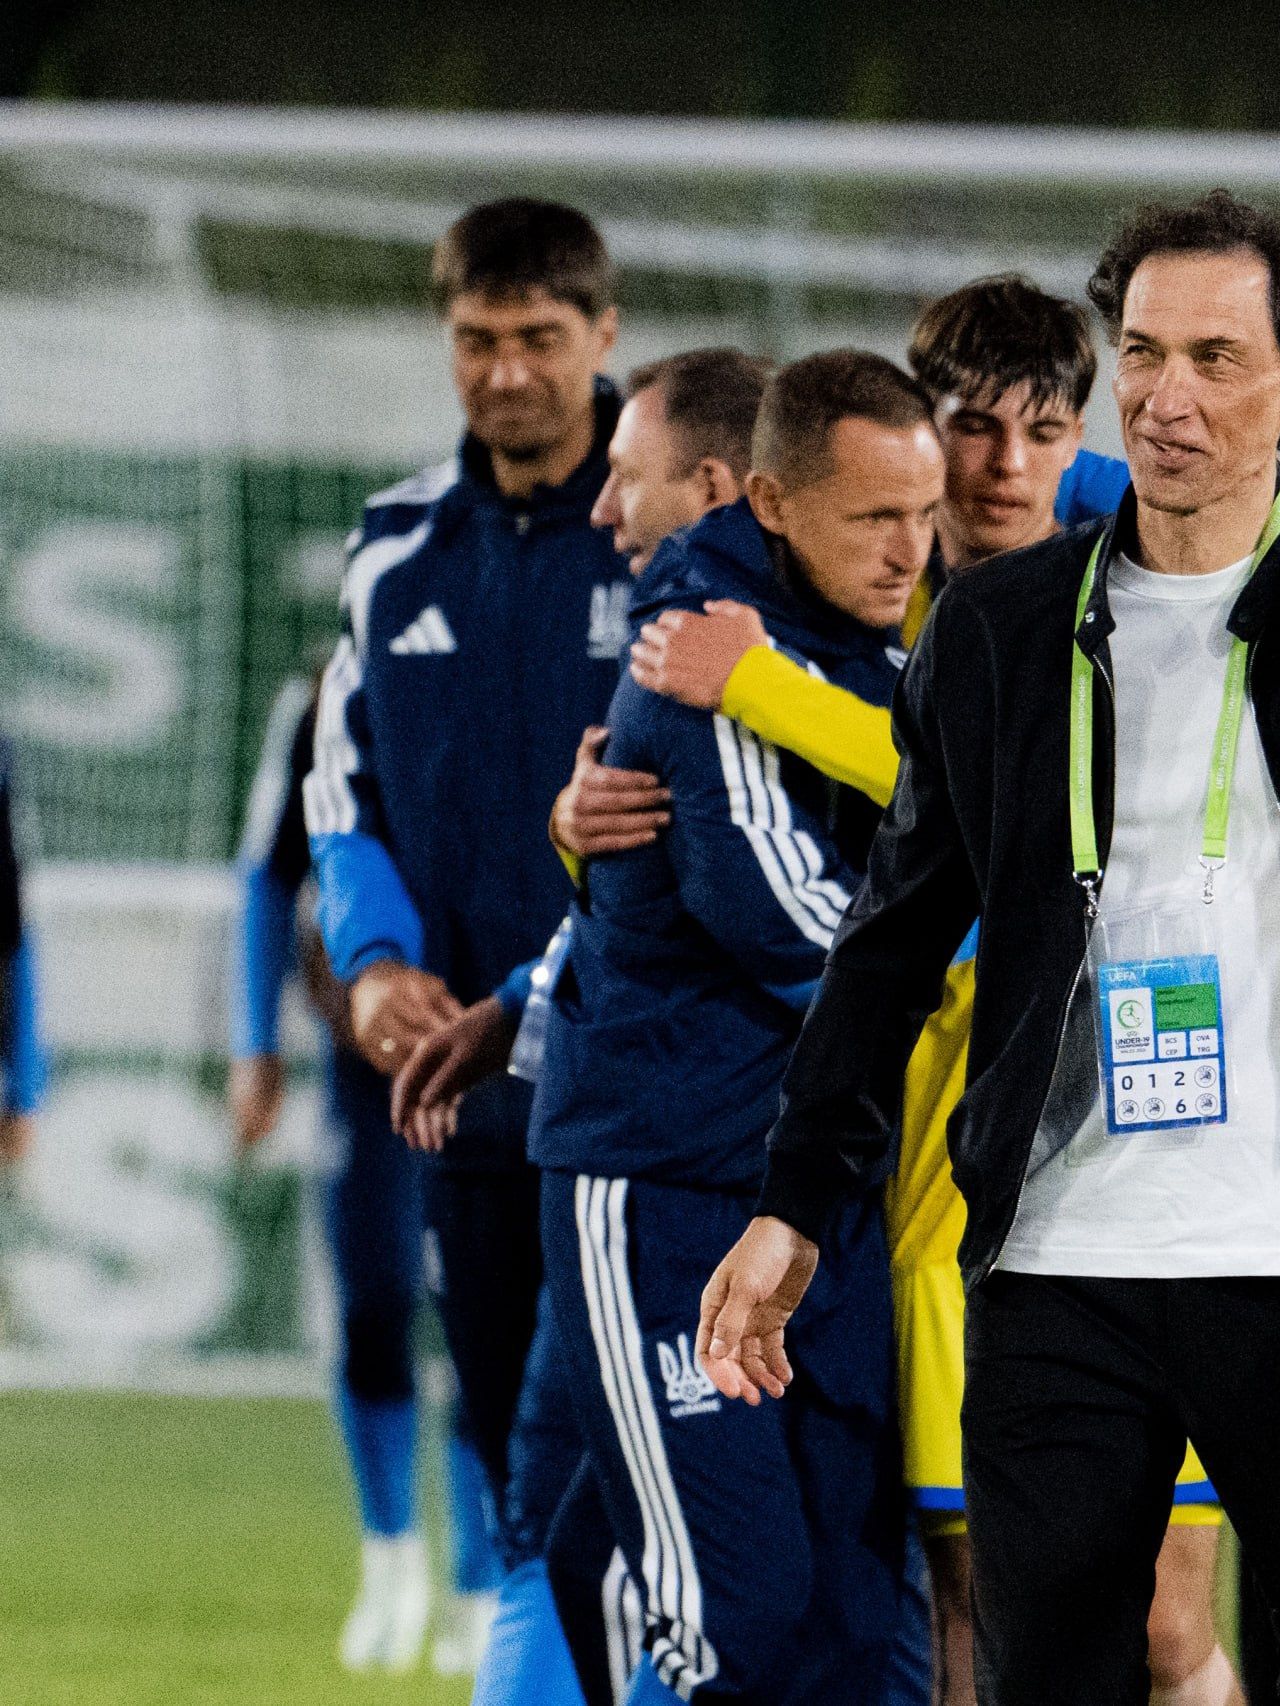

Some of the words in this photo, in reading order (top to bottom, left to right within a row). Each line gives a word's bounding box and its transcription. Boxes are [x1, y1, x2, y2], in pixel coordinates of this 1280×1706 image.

[1121, 1075, 1133, 1090] 0
[1148, 1073, 1156, 1088] 1
[1174, 1071, 1185, 1086] 2
[1175, 1098, 1187, 1113] 6
